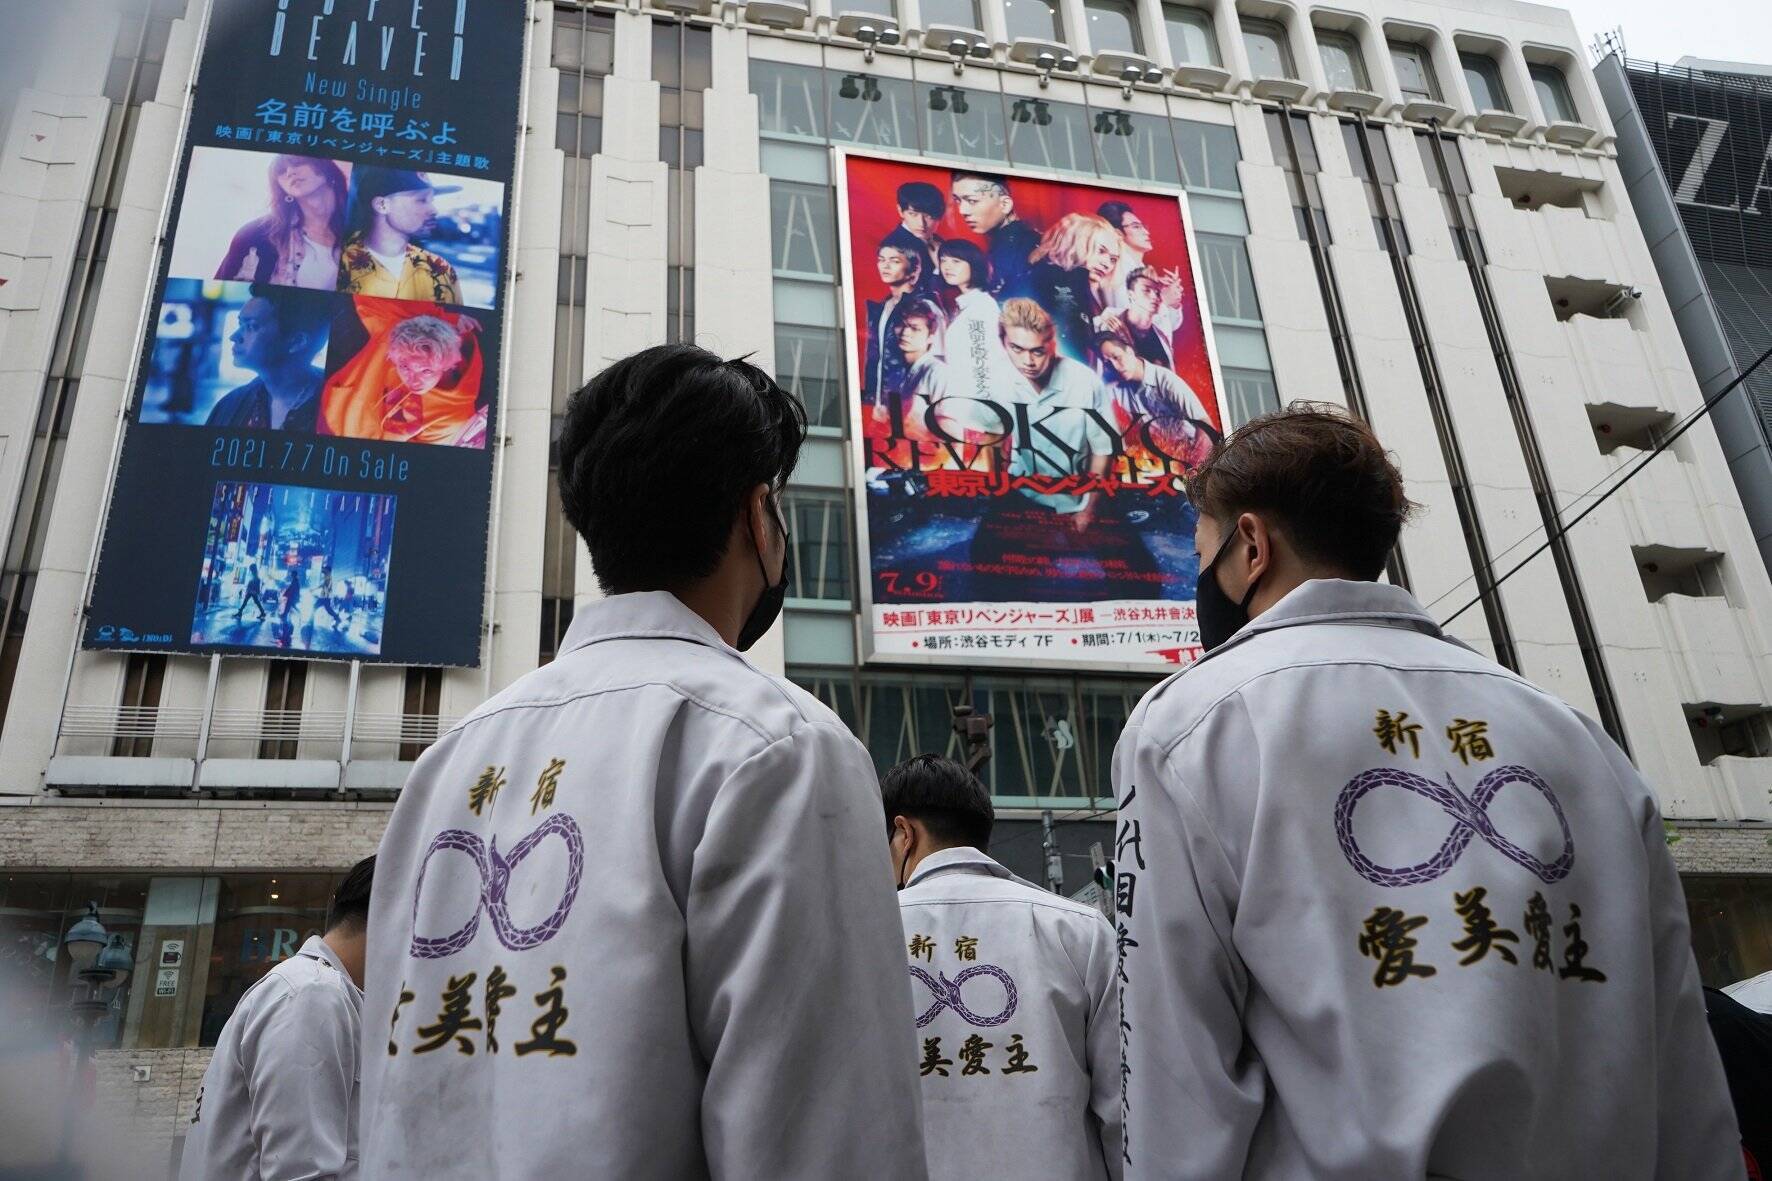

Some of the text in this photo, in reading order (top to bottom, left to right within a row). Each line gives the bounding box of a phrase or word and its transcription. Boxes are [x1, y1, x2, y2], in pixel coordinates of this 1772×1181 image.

[270, 11, 464, 81] BEAVER
[305, 72, 422, 111] New Single
[255, 98, 457, 145] 名前を呼ぶよ
[215, 124, 490, 170] 映画『東京リベンジャーズ』主題歌
[211, 437, 410, 482] 2021.7.7 On Sale
[924, 468, 1178, 498] 東京リベンジャーズ
[879, 572, 937, 593] 7.9
[883, 608, 1094, 627] 映画「東京リベンジャーズ」展
[1033, 635, 1053, 648] 7F
[1373, 709, 1495, 765] 新宿
[469, 758, 565, 820] 新宿
[908, 934, 979, 962] 新宿
[388, 965, 577, 1057] 美主
